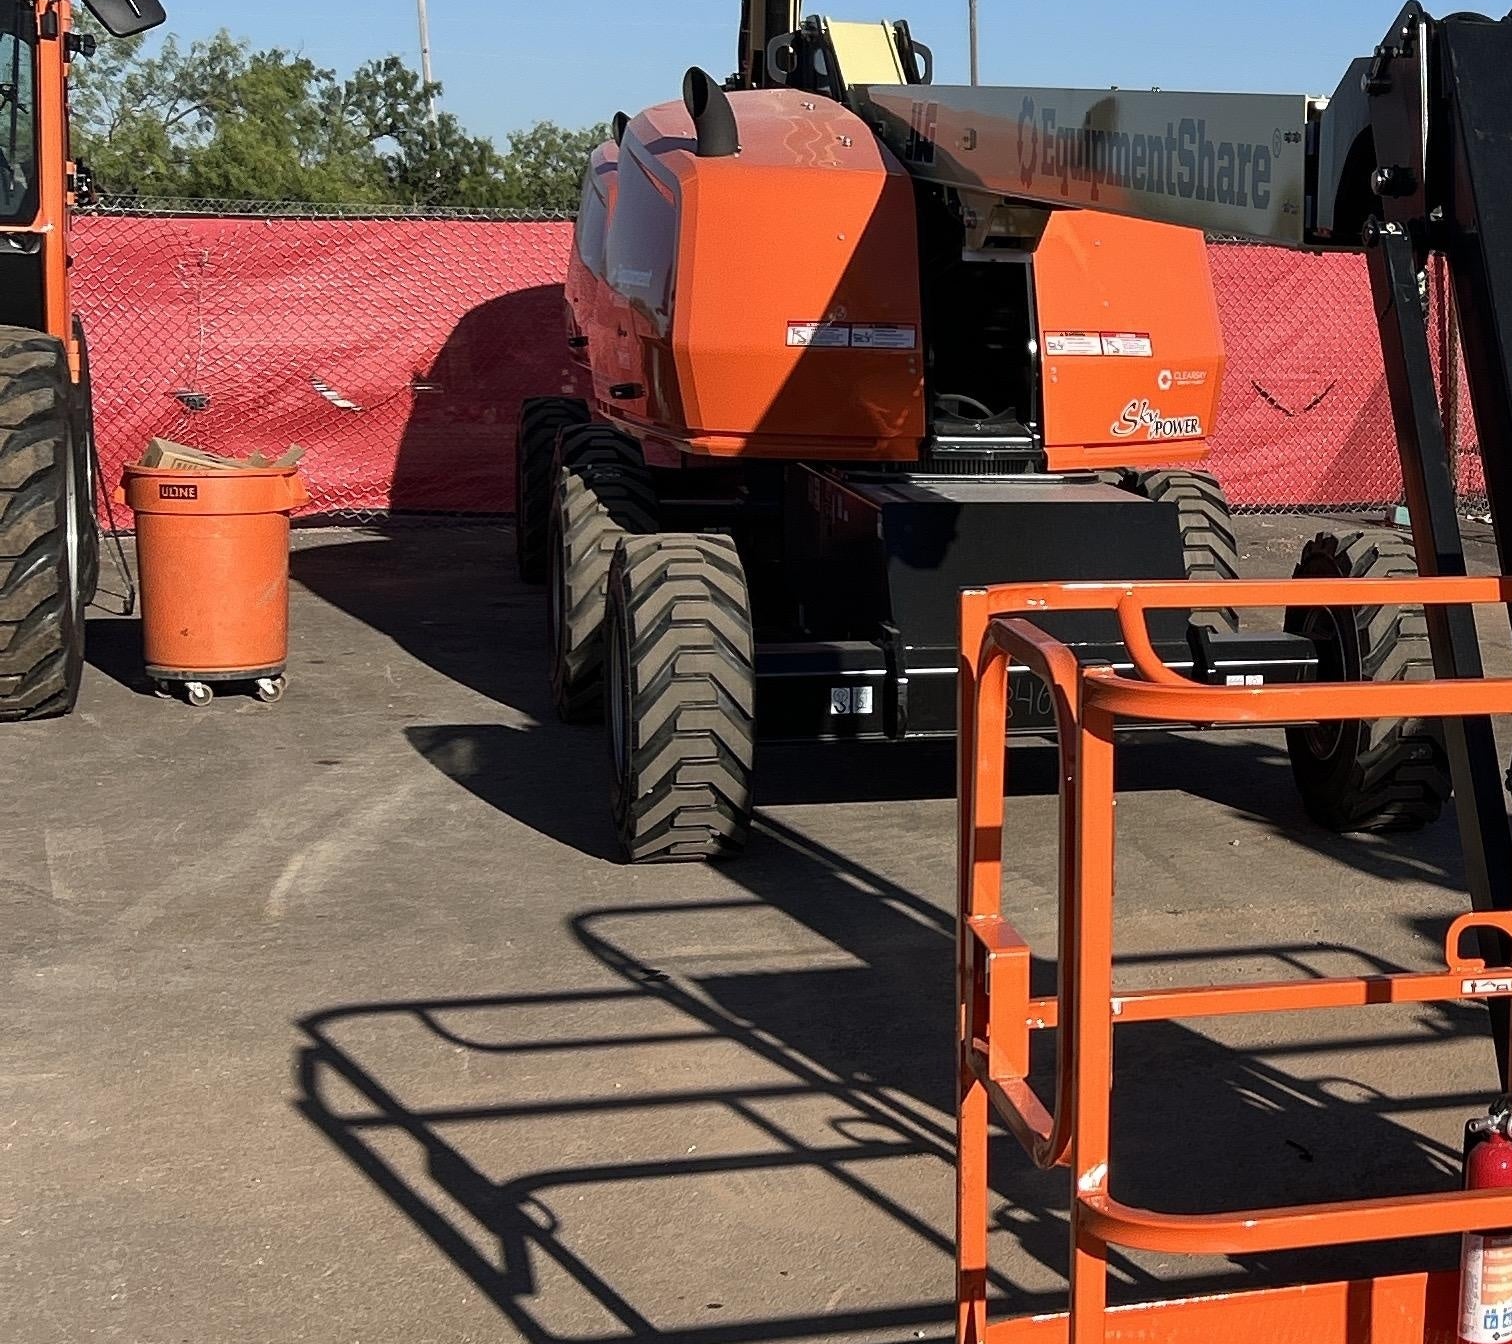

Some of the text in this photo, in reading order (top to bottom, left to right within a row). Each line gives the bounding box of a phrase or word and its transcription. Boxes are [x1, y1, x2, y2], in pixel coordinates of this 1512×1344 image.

[1040, 107, 1272, 210] EquipmentShare
[1155, 418, 1199, 435] POWER
[161, 486, 196, 498] ULINE
